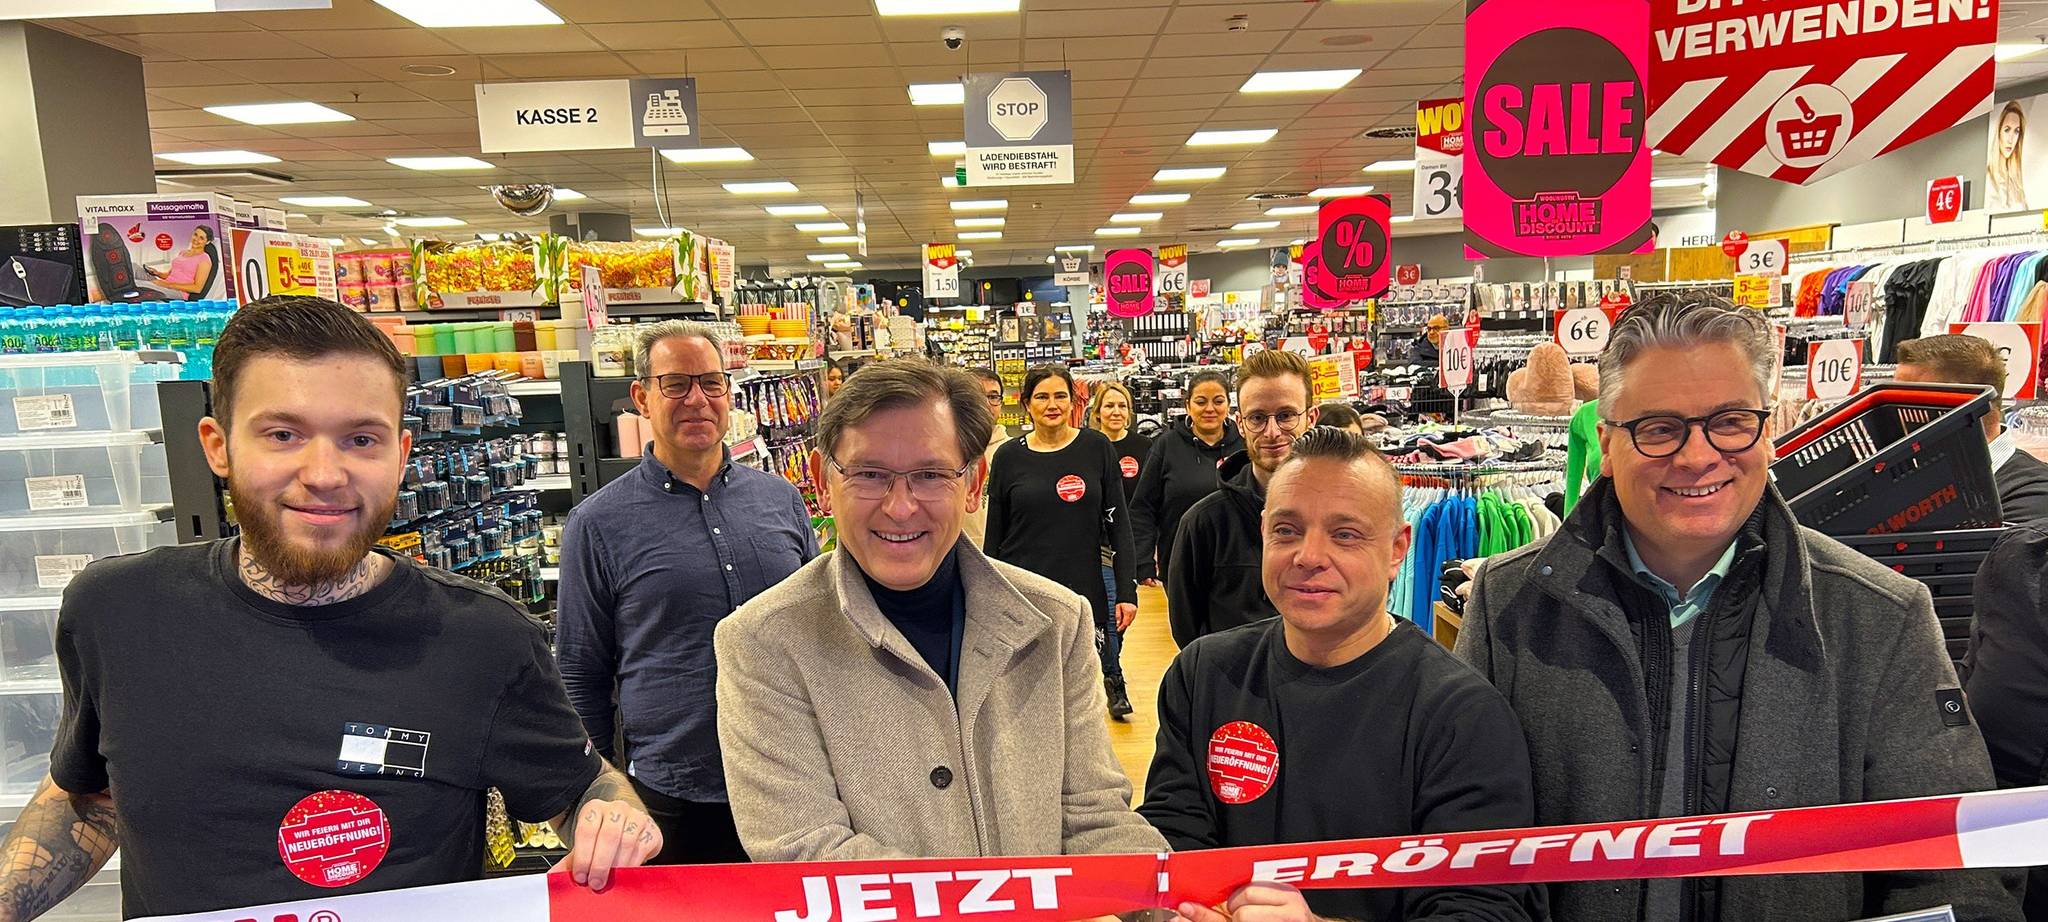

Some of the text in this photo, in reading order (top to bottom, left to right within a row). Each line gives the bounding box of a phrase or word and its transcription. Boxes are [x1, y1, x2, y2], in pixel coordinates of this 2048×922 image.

[1655, 0, 1990, 62] VERWENDEN!
[516, 107, 598, 125] KASSE 2
[996, 102, 1039, 116] STOP
[1417, 101, 1464, 136] WO
[1483, 82, 1634, 159] SALE
[1443, 136, 1464, 144] HOM
[980, 152, 1059, 161] LADENDIEBSTAHL
[982, 161, 1057, 170] WIRD BESTRAFT!
[151, 203, 205, 212] Massagematte
[1936, 190, 1954, 210] 4€
[1519, 202, 1595, 223] HOME
[1520, 221, 1594, 235] DISCOUNT
[928, 244, 956, 259] WOW!
[1159, 245, 1188, 260] WOW!
[1336, 220, 1373, 268] %
[1749, 251, 1775, 269] 3€
[1110, 274, 1149, 293] SALE
[1163, 272, 1185, 291] 6€
[1403, 270, 1416, 279] 3€
[936, 279, 958, 291] 1.50
[1849, 292, 1868, 313] 10€
[506, 311, 532, 321] 125
[1570, 320, 1599, 340] 6€
[1446, 346, 1468, 371] 10€
[1817, 357, 1853, 383] 10€
[1866, 483, 1958, 535] OLWORTH
[350, 725, 425, 742] TOMMY
[294, 817, 371, 839] WIR FEIERN MIT DIR
[288, 826, 381, 853] NEUERÖFFNUNG!
[1251, 813, 1775, 884] ERÖFFNET
[326, 863, 358, 877] HOME
[774, 867, 1073, 922] JETZT
